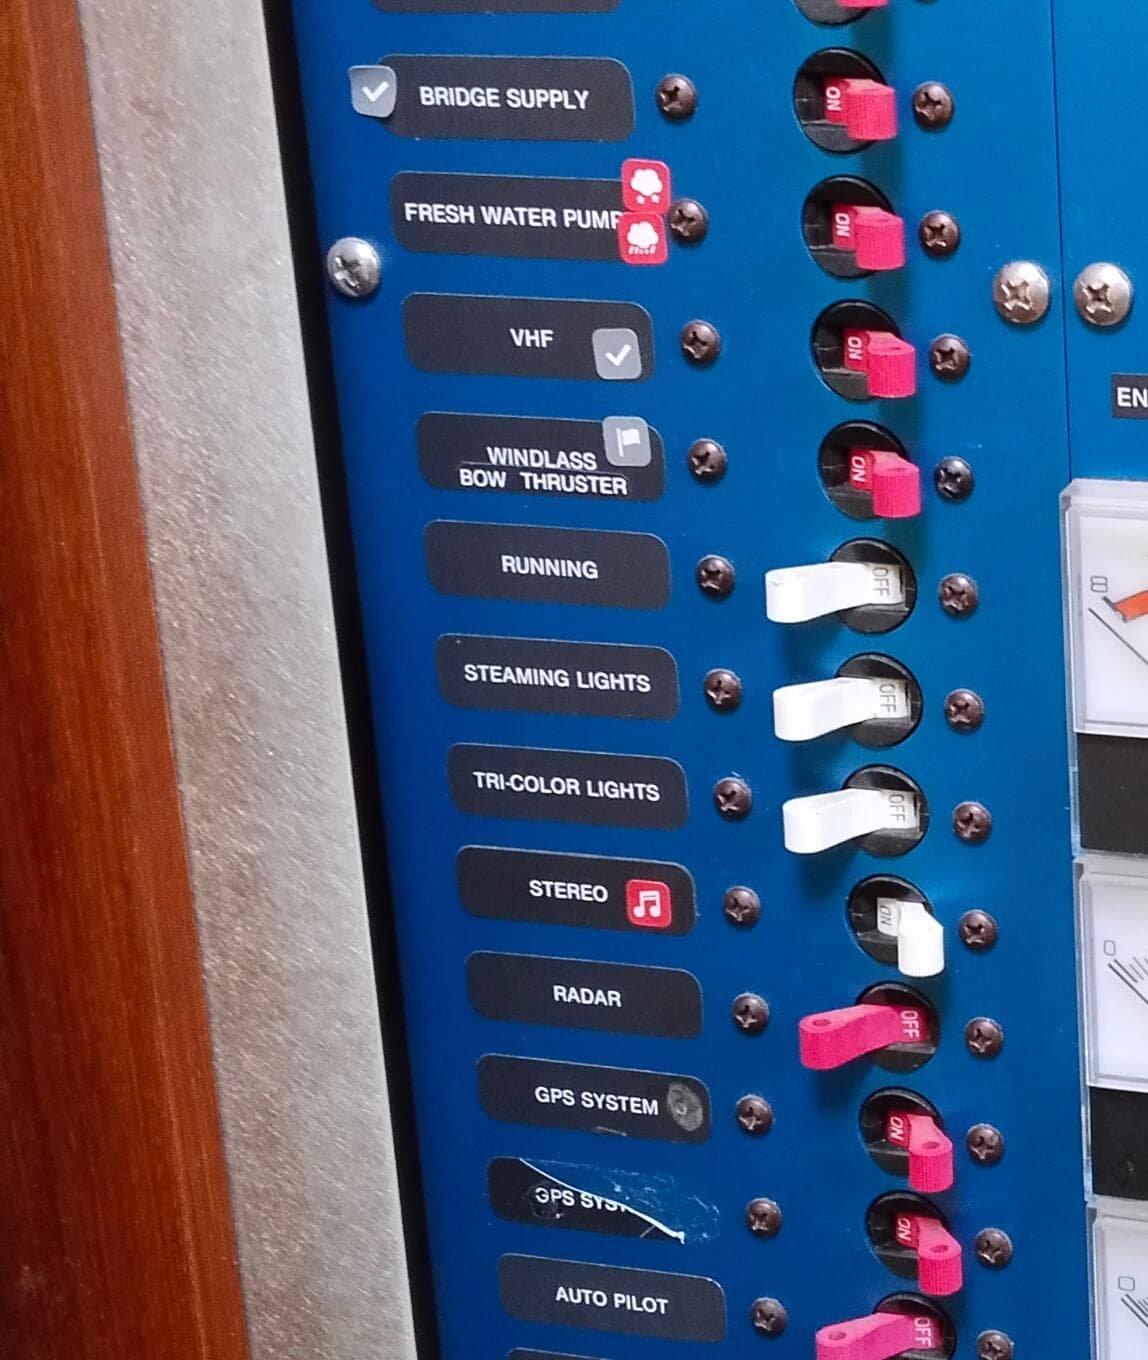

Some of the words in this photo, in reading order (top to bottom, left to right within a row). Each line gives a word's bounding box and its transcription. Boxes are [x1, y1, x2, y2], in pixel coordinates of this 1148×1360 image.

[418, 86, 500, 108] BRIDGE
[506, 88, 589, 110] SUPPLY
[825, 86, 842, 112] ON
[404, 202, 474, 225] FRESH
[480, 206, 557, 228] WATER
[835, 212, 851, 238] ON
[510, 328, 553, 348] VHF
[848, 336, 863, 361] ON
[487, 447, 597, 470] WINDLASS
[852, 456, 866, 482] ON
[459, 470, 506, 488] BOW
[520, 472, 627, 495] THRUSTER
[501, 555, 598, 579] RUNNING
[873, 567, 889, 597] OFF
[1090, 576, 1108, 593] 8
[464, 664, 569, 688] STEAMING
[576, 671, 650, 693] LIGHTS
[879, 683, 896, 713] OFF
[473, 772, 581, 796] TRI-COLOR
[587, 780, 660, 801] LIGHTS
[888, 793, 905, 823] OFF
[529, 881, 608, 902] STEREO
[553, 986, 622, 1007] RADAR
[900, 1010, 919, 1039] OFF
[535, 1087, 575, 1107] GPS
[580, 1091, 659, 1116] SYSTEM
[891, 1116, 904, 1140] ON
[535, 1187, 575, 1207] GPS
[898, 1218, 911, 1241] ON
[555, 1287, 608, 1308] AUTO
[614, 1293, 668, 1315] PILOT
[913, 1317, 932, 1348] OFF
